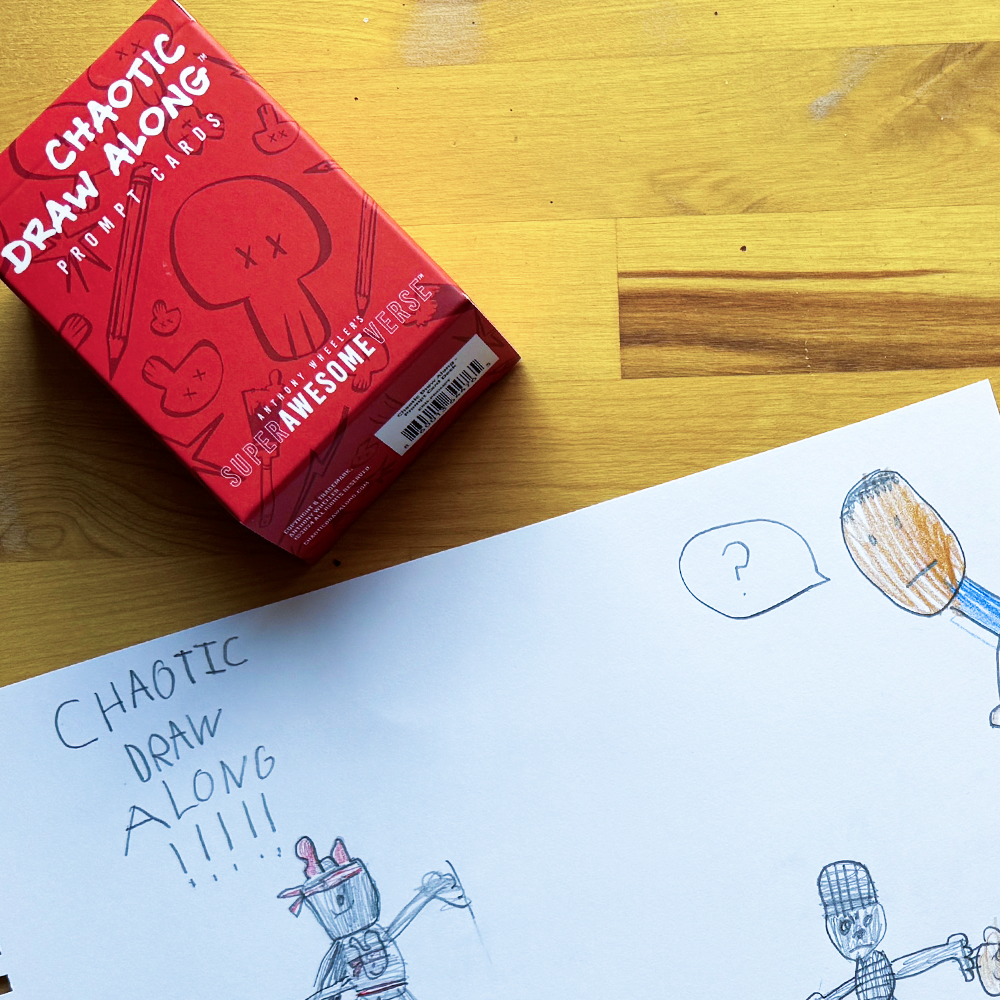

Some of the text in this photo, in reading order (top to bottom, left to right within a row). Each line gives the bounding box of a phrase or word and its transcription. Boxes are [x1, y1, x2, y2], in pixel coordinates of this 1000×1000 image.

[46, 33, 185, 170] CHAOTIC
[1, 171, 99, 274] DRAW
[58, 112, 222, 274] PROMPT CARDS
[256, 315, 364, 421] ANTHONY WHEELER'S
[283, 505, 314, 535] COPYRIGHT
[289, 512, 314, 538] ANTHONY
[721, 540, 751, 597] ?
[54, 636, 248, 749] CHAOTIC
[124, 708, 222, 783] DRAW
[124, 745, 276, 857] ALONG
